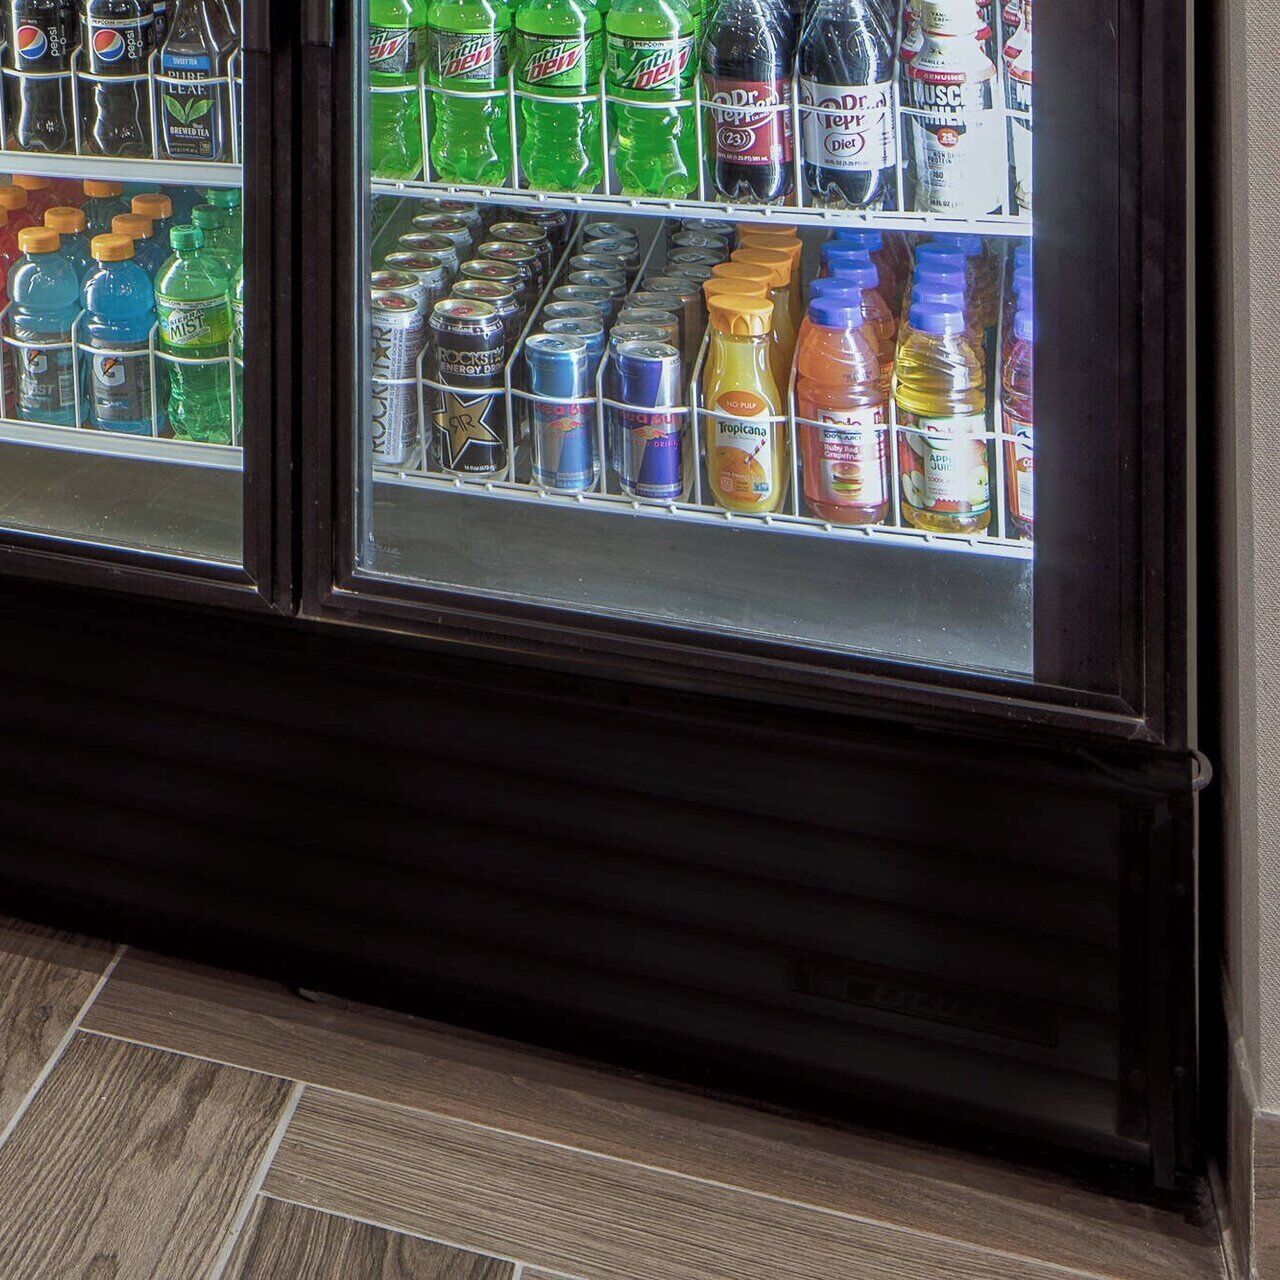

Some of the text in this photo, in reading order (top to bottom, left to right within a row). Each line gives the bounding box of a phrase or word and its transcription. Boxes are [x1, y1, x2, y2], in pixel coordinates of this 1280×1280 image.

[47, 26, 60, 57] pepsi
[128, 30, 137, 60] pepsi
[170, 126, 197, 136] BREWED
[831, 136, 858, 151] Diet
[441, 363, 480, 374] ENERGY
[726, 400, 757, 410] NO PULP
[717, 421, 768, 438] Tropicana
